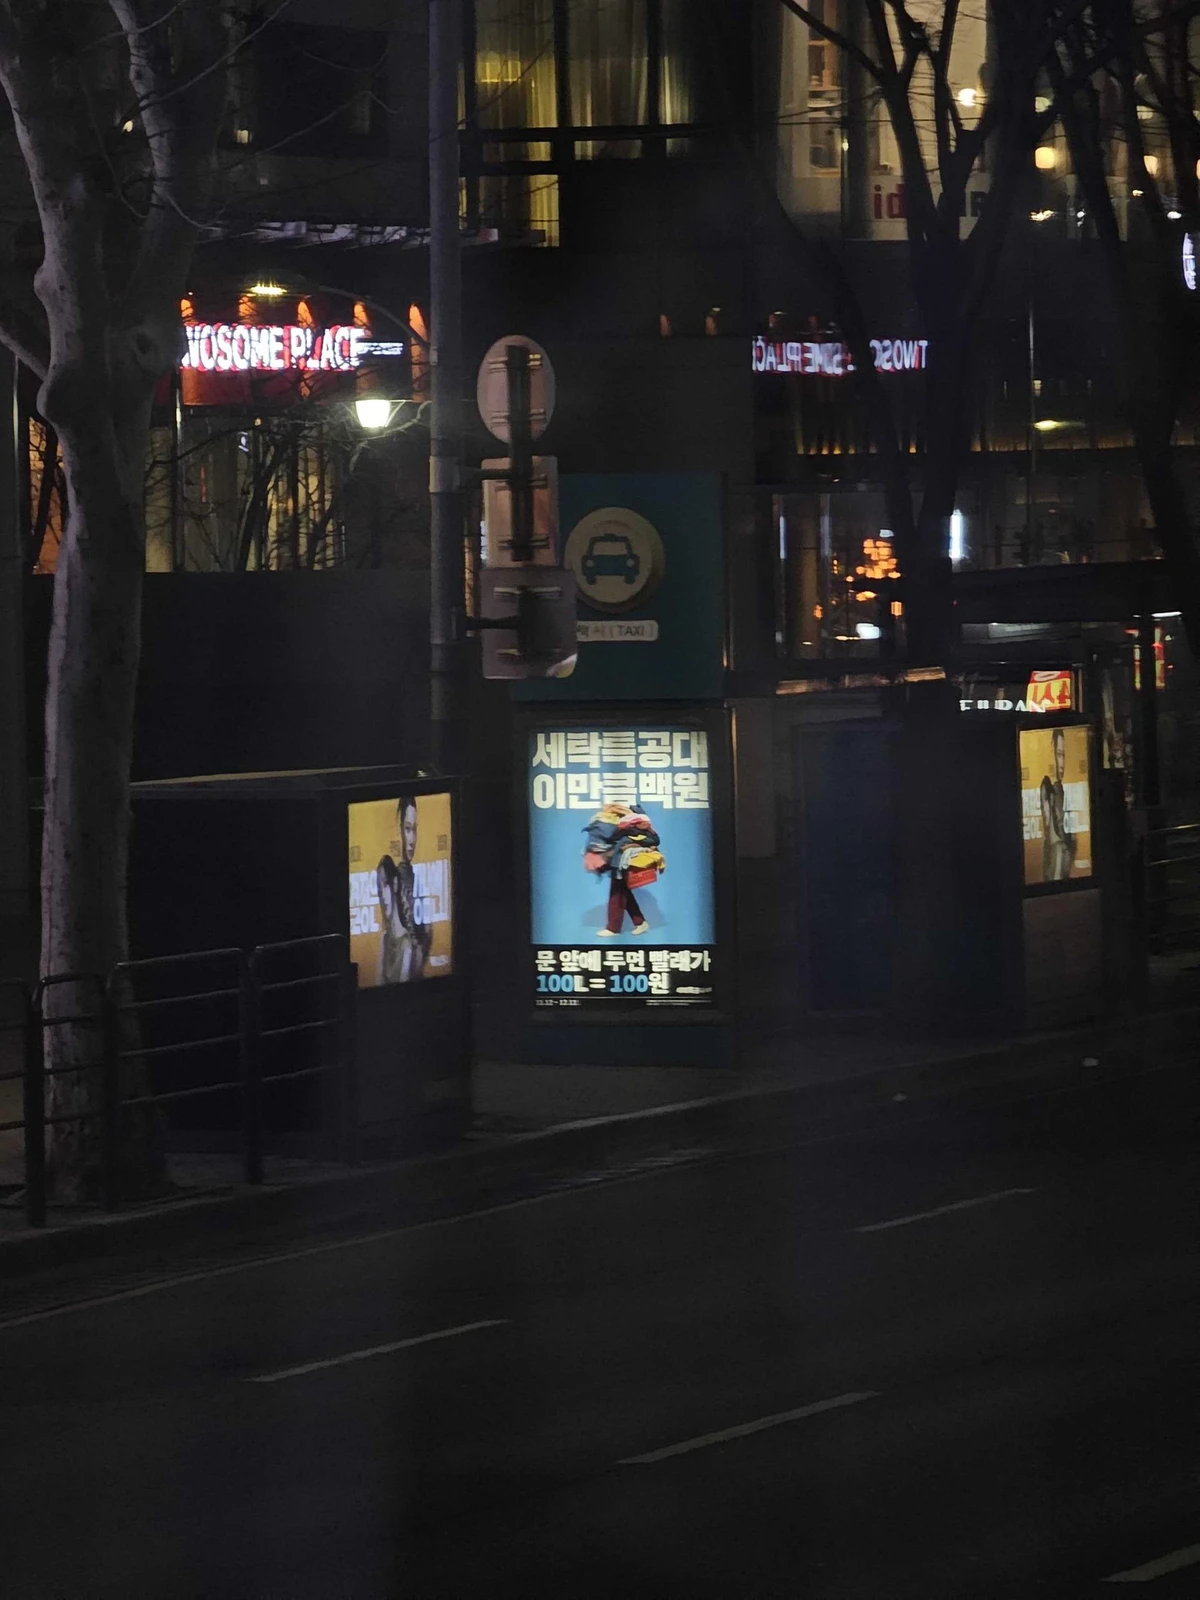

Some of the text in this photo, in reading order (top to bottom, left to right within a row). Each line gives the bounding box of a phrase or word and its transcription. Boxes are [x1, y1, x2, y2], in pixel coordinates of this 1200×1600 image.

[532, 731, 709, 769] 세탁특공대
[535, 950, 711, 972] 문 앞에 두면 빨래가
[536, 974, 590, 993] 100L
[609, 973, 670, 994] 100원
